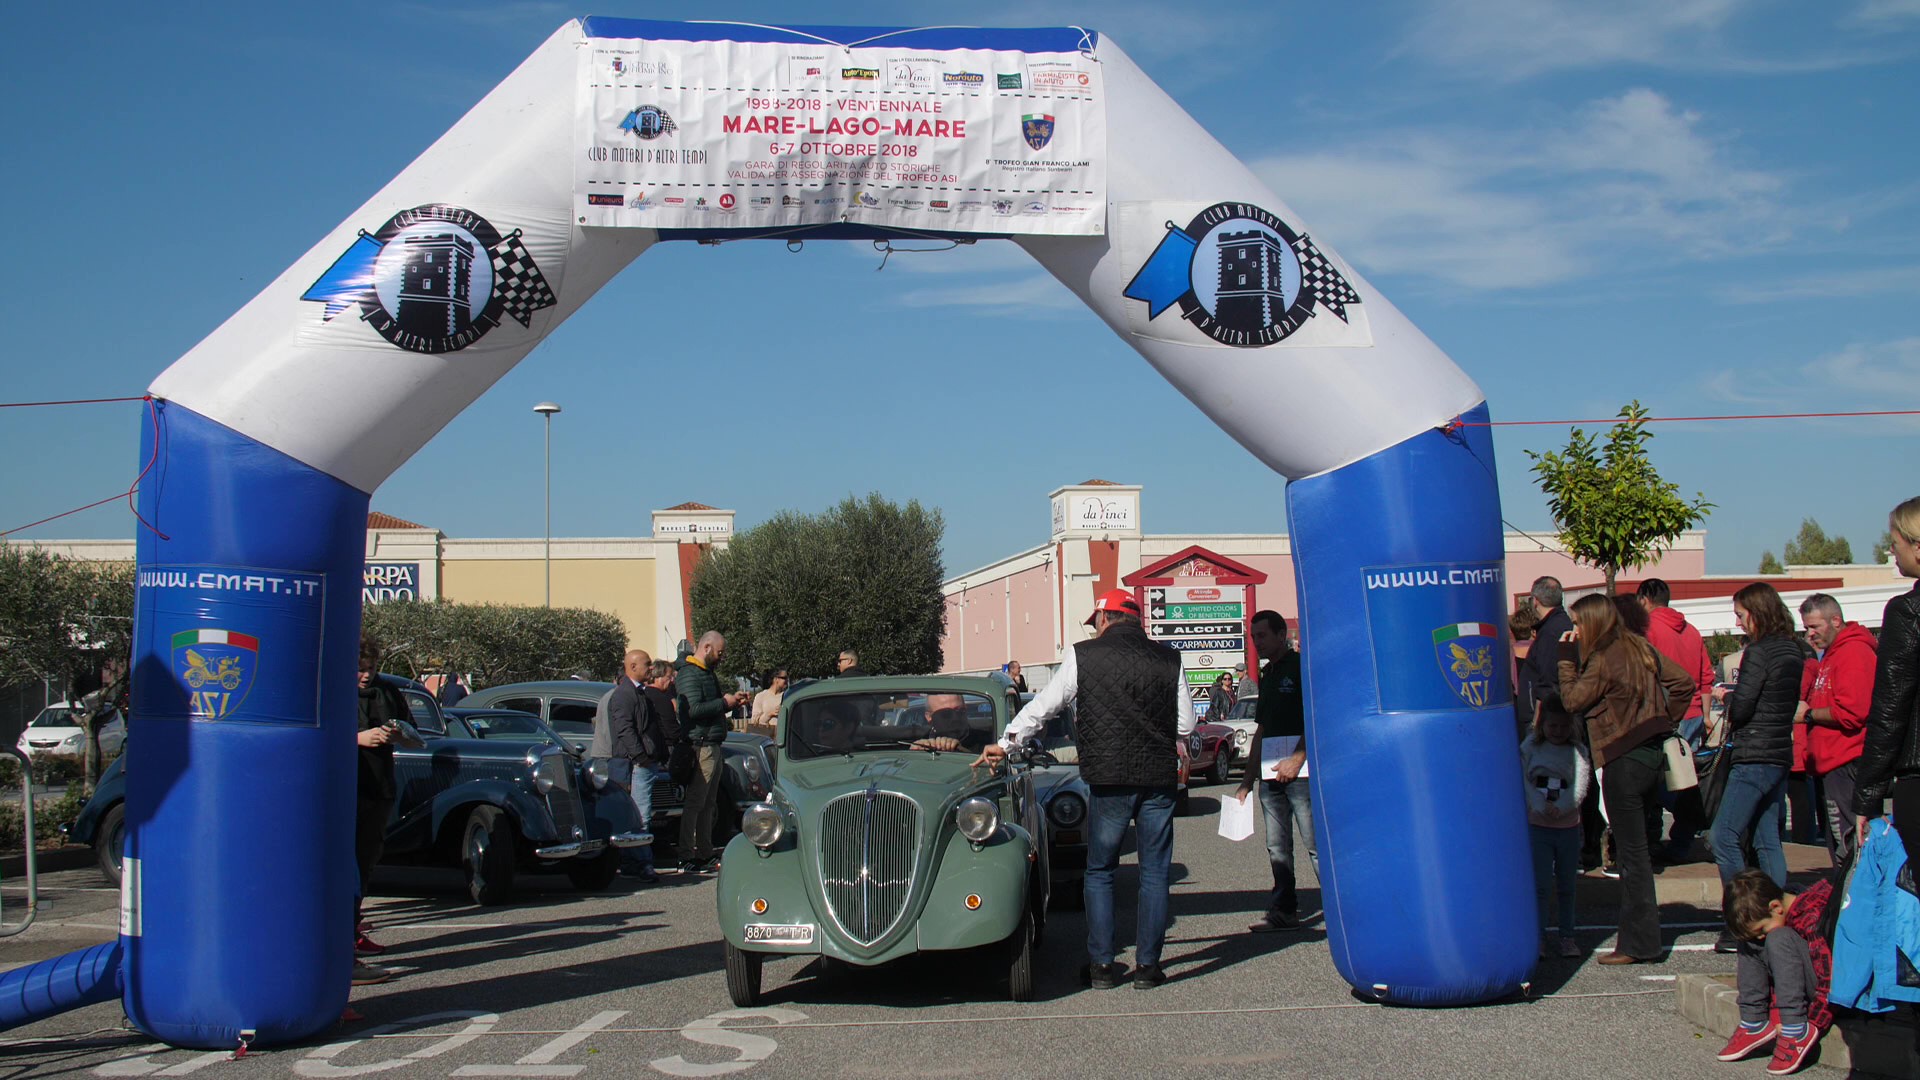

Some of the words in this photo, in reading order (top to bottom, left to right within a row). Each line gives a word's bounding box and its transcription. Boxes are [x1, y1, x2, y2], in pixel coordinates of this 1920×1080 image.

[945, 74, 982, 82] Norauto
[836, 99, 942, 113] VENTENNALE
[722, 115, 966, 138] MARE-LAGO-MARE
[588, 147, 608, 161] CLUB
[612, 148, 644, 163] MOTORI
[648, 148, 678, 164] D'ALTRI
[682, 149, 708, 164] TEMPI
[770, 142, 795, 155] 6-7
[800, 142, 877, 156] OTTOBRE
[882, 144, 918, 158] 2018
[744, 160, 774, 170] GARA
[778, 160, 788, 169] DI
[860, 162, 888, 170] AUTO
[890, 162, 942, 172] STORICHE
[728, 170, 766, 179] VALIDA
[768, 171, 788, 179] PER
[791, 170, 870, 179] ASSEGNAZIONE
[873, 172, 892, 181] DEL
[896, 173, 938, 182] TROFEO
[940, 174, 958, 182] ASI
[394, 207, 423, 229] CLUB
[1204, 205, 1231, 226] CLUB
[1237, 204, 1280, 230] MOTORI
[380, 321, 434, 352] D'ALTRI
[442, 324, 482, 352] TEMPI
[1200, 319, 1250, 344] D'ALTRI
[1259, 315, 1298, 344] TEMPI
[364, 566, 413, 586] RPA
[362, 587, 414, 606] NDO
[1174, 625, 1234, 633] ALCOTT
[1171, 640, 1235, 650] SCARPAMONDO
[747, 927, 772, 938] 8870
